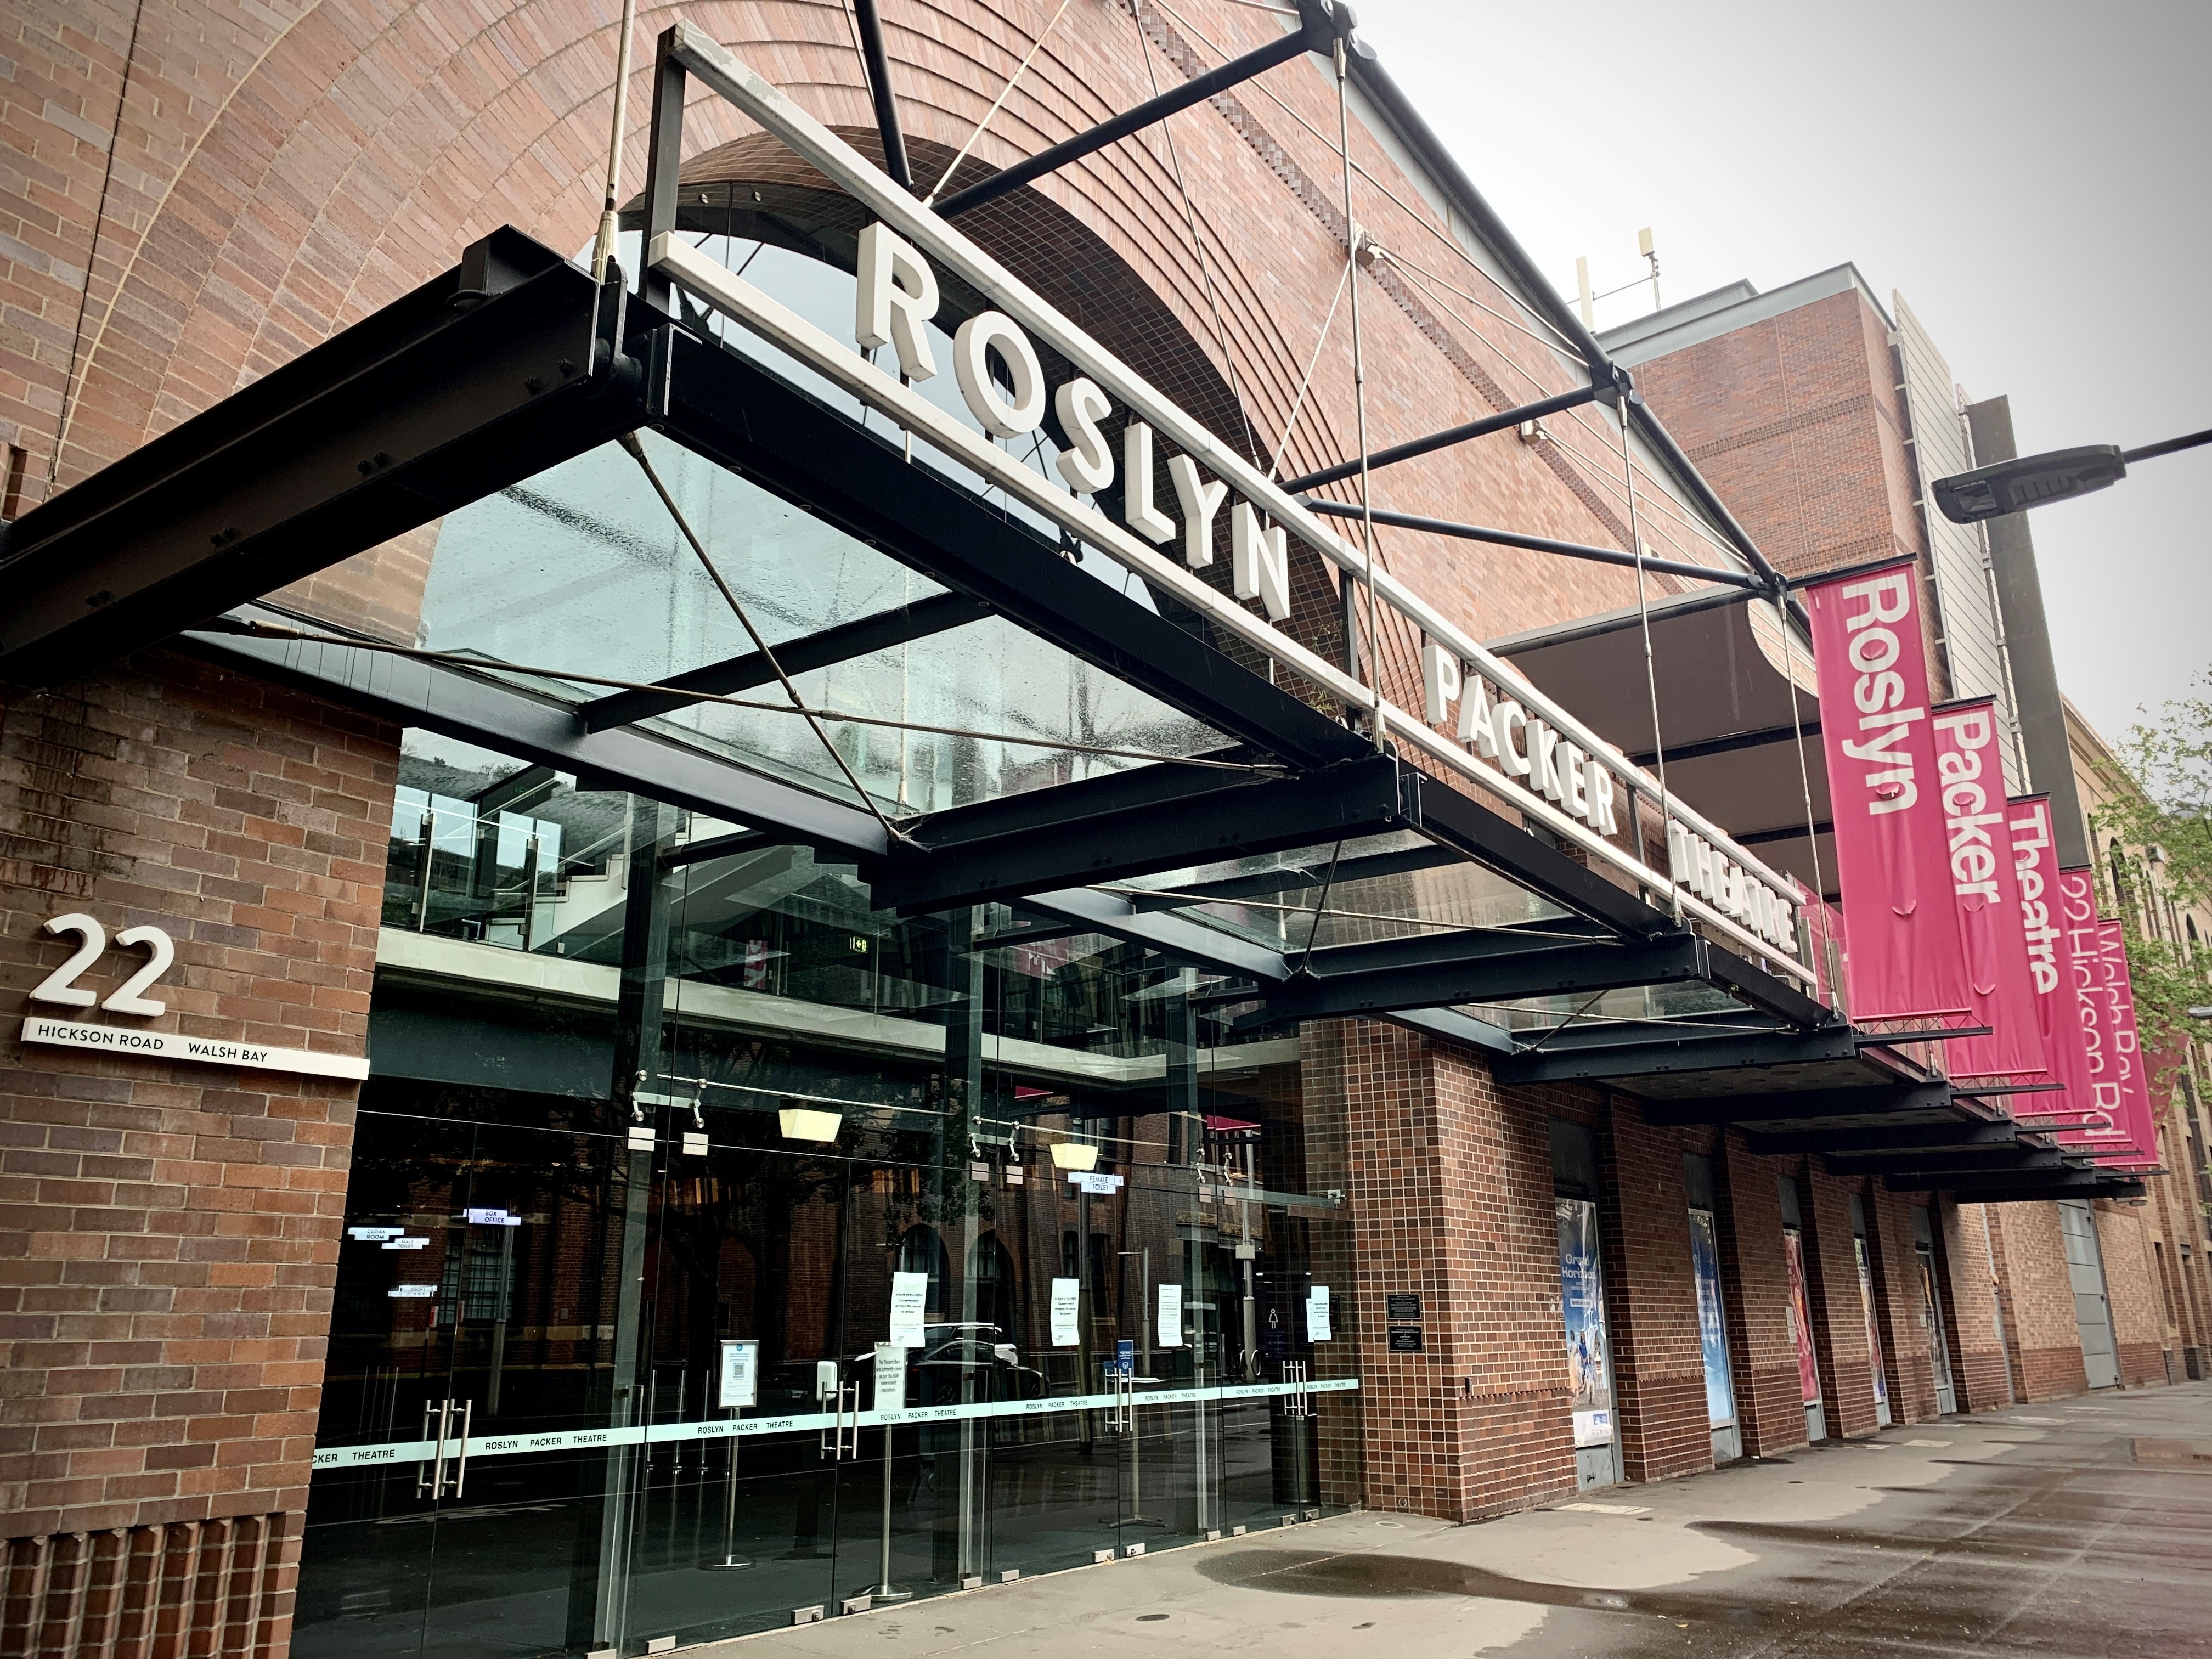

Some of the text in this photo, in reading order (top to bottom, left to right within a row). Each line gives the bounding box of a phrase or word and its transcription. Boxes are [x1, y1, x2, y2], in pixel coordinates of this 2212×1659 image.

[855, 221, 1290, 622] ROSLYN
[1422, 644, 1618, 835] PACKER
[1841, 572, 1926, 816] Roslyn
[1933, 710, 2004, 904] Packer
[1668, 818, 1798, 953] THEATRE
[2008, 804, 2061, 995] Theatre
[2060, 876, 2091, 922] 22
[29, 912, 175, 1017] 22
[38, 1024, 268, 1063] HICKSON ROAD WALSH BAY
[1565, 1253, 1590, 1266] Grand
[352, 1449, 396, 1461] THEATRE
[485, 1434, 607, 1450] ROSLYN PACKER THEATRE
[698, 1420, 793, 1434] ROSLYN PACKER THEATRE
